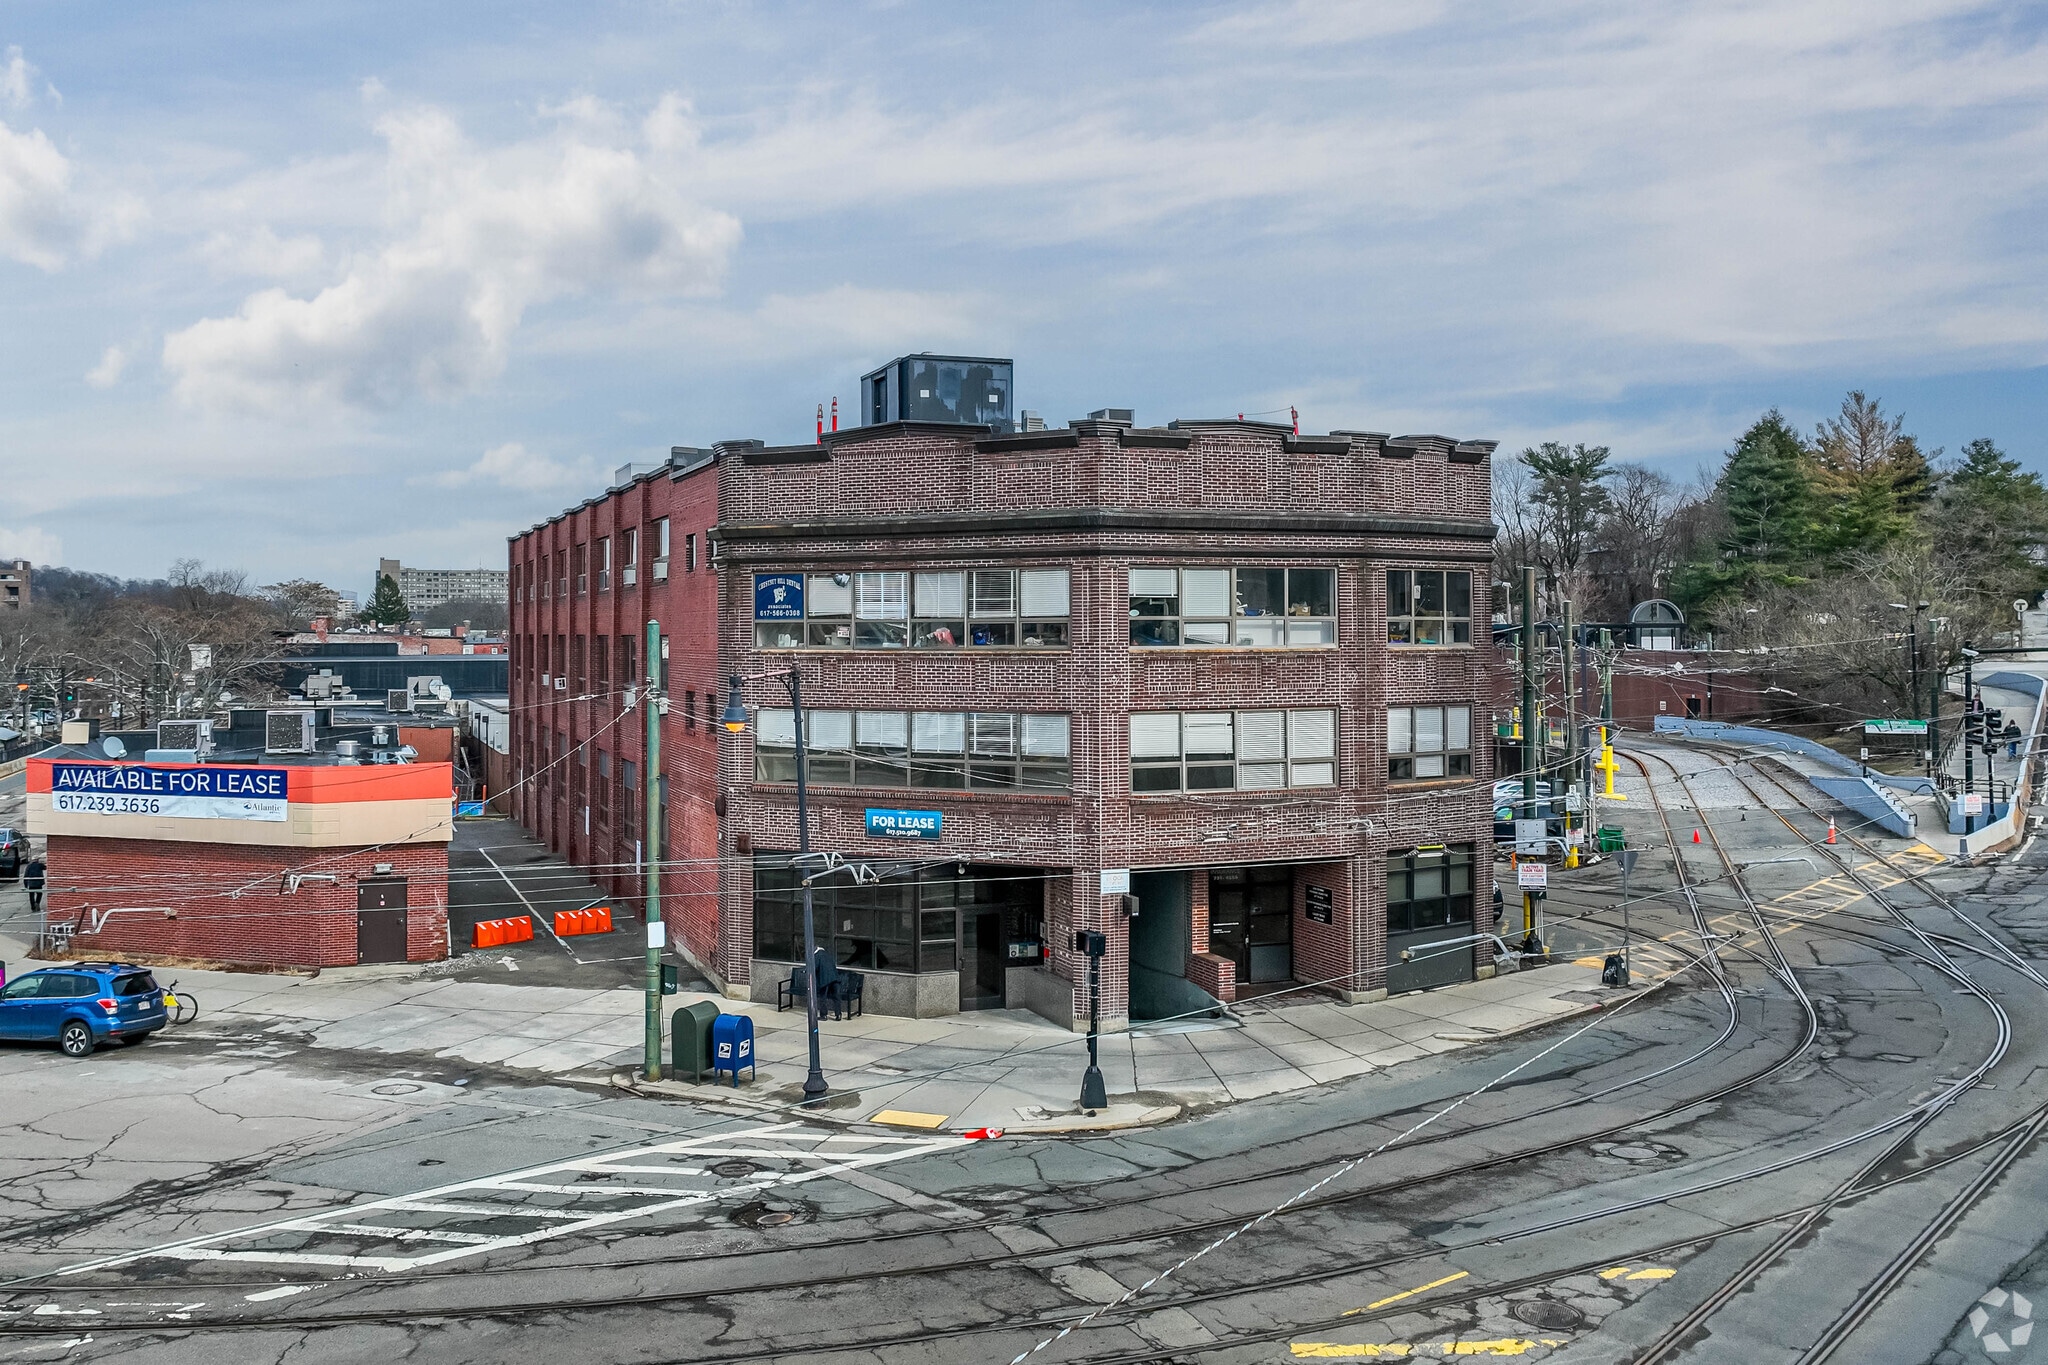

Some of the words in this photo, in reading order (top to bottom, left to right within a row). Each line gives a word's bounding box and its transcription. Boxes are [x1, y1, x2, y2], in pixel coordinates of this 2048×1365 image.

[58, 768, 164, 791] AVAILABLE
[168, 772, 211, 793] FOR
[216, 774, 281, 795] LEASE
[59, 794, 160, 814] 617.239.3636
[252, 802, 282, 811] Atlantic
[872, 816, 895, 827] FOR
[898, 817, 934, 829] LEASE
